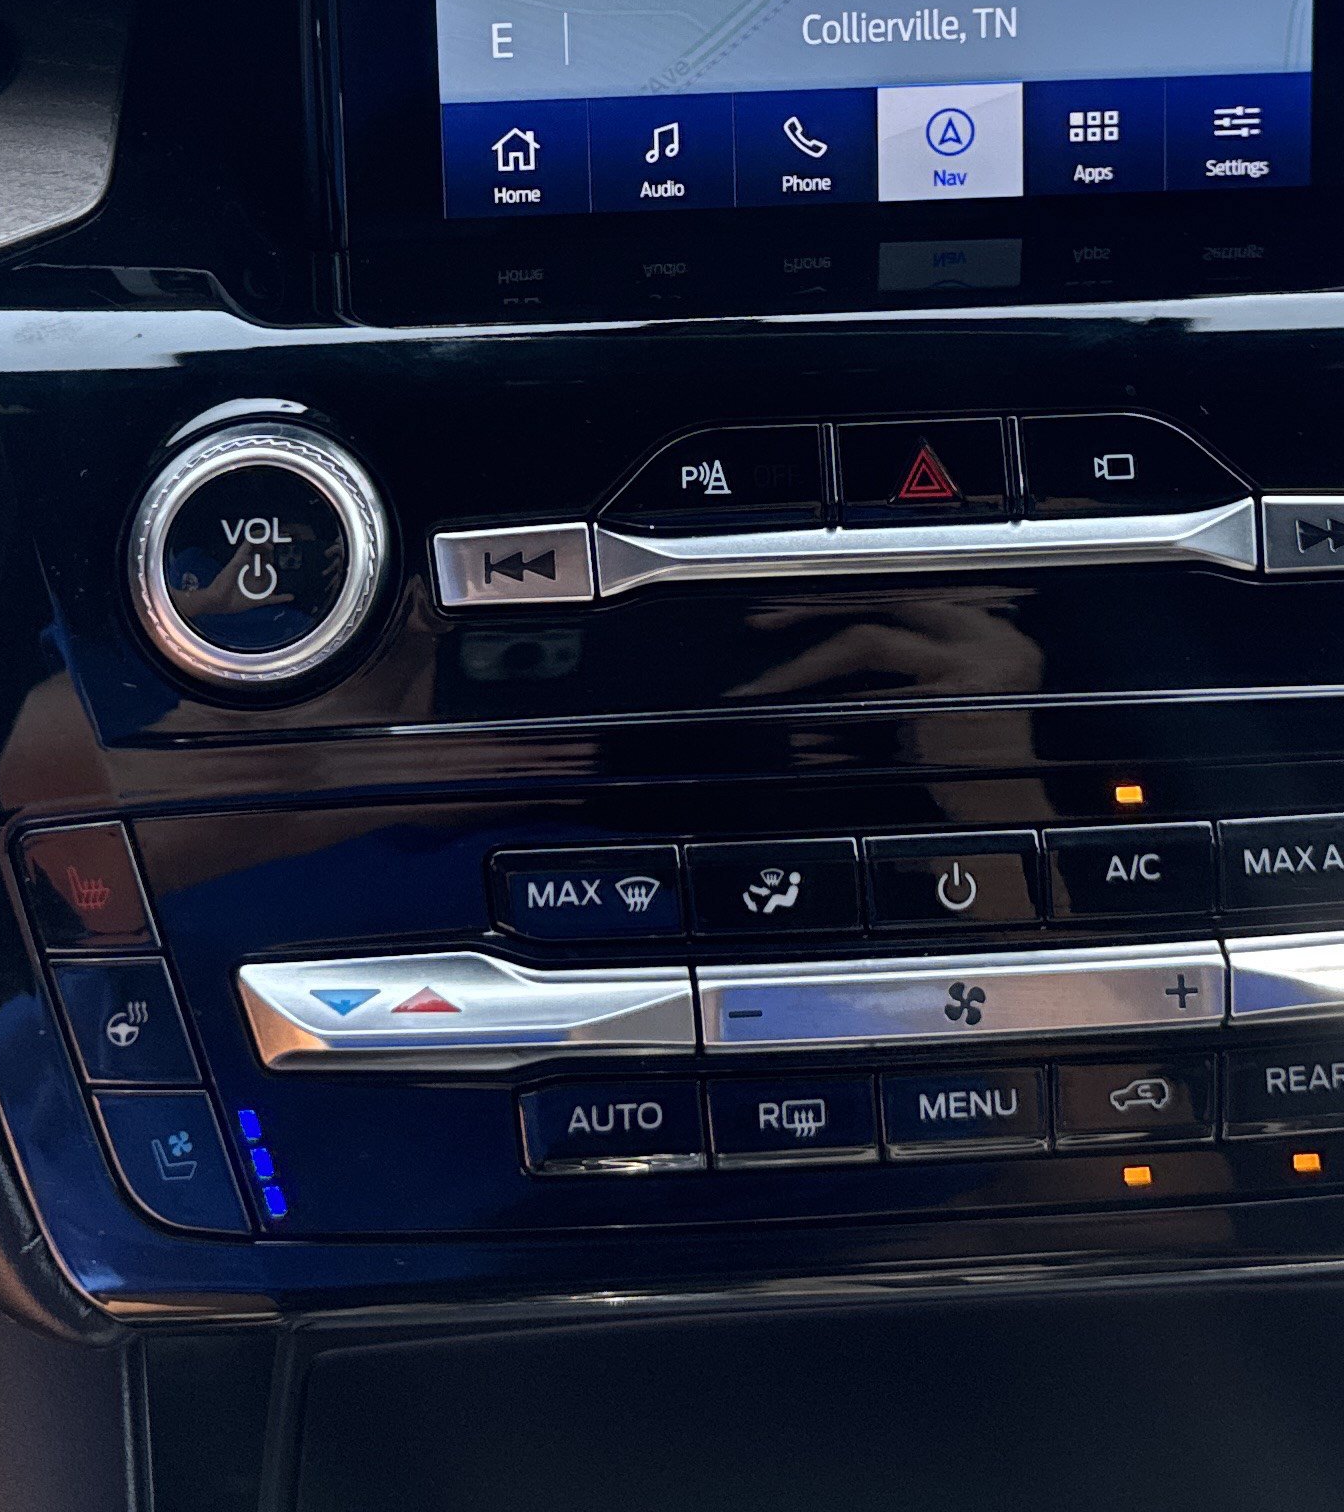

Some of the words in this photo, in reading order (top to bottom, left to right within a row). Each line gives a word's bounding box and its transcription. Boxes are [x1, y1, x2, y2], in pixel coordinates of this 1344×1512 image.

[802, 10, 967, 45] Collierville,
[973, 6, 1017, 39] TN
[491, 22, 514, 59] E
[933, 169, 968, 187] Nav
[1073, 164, 1114, 184] Apps
[1205, 158, 1270, 179] Settings
[493, 186, 541, 204] Home
[640, 179, 685, 198] Audio
[782, 174, 832, 193] Phone
[221, 517, 292, 545] VOL
[1105, 852, 1161, 882] A/C
[1243, 845, 1316, 874] MAX
[527, 879, 602, 909] MAX
[567, 1101, 663, 1133] AUTO
[919, 1088, 1018, 1120] MENU
